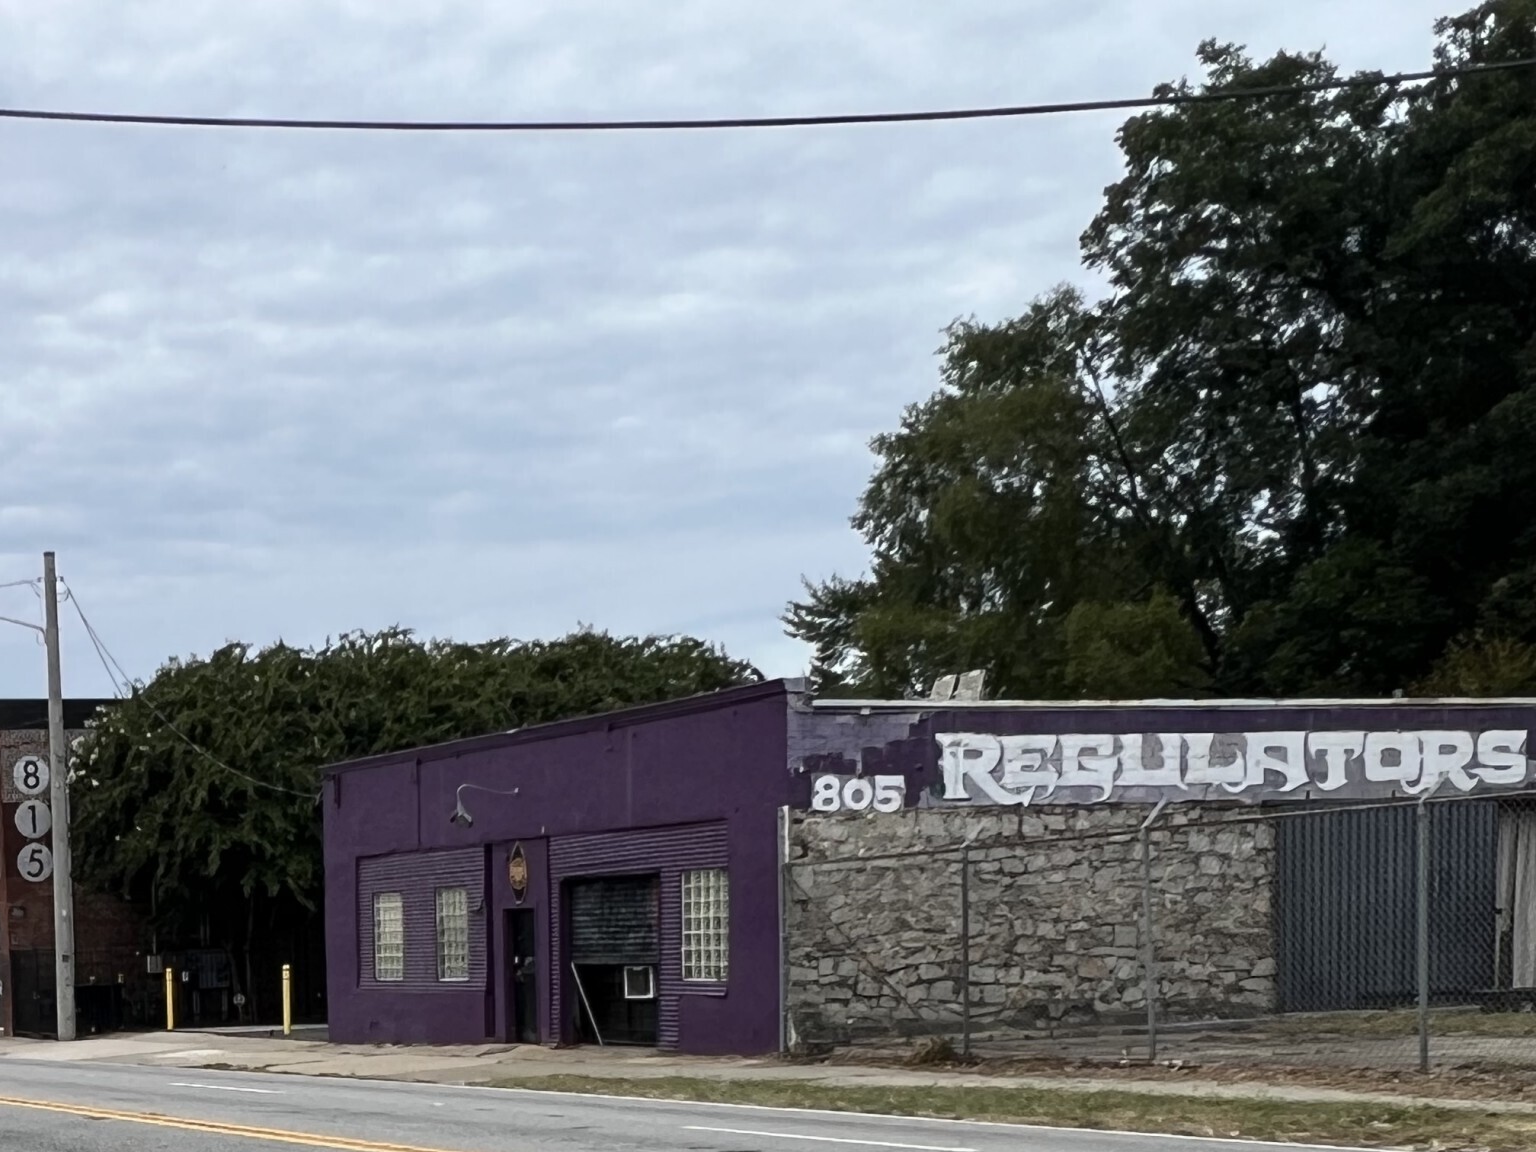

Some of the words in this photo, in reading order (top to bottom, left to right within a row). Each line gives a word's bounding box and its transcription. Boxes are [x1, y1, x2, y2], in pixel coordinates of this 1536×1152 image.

[812, 775, 906, 813] 805
[934, 729, 1529, 806] REGULATORS
[23, 760, 44, 878] 815
